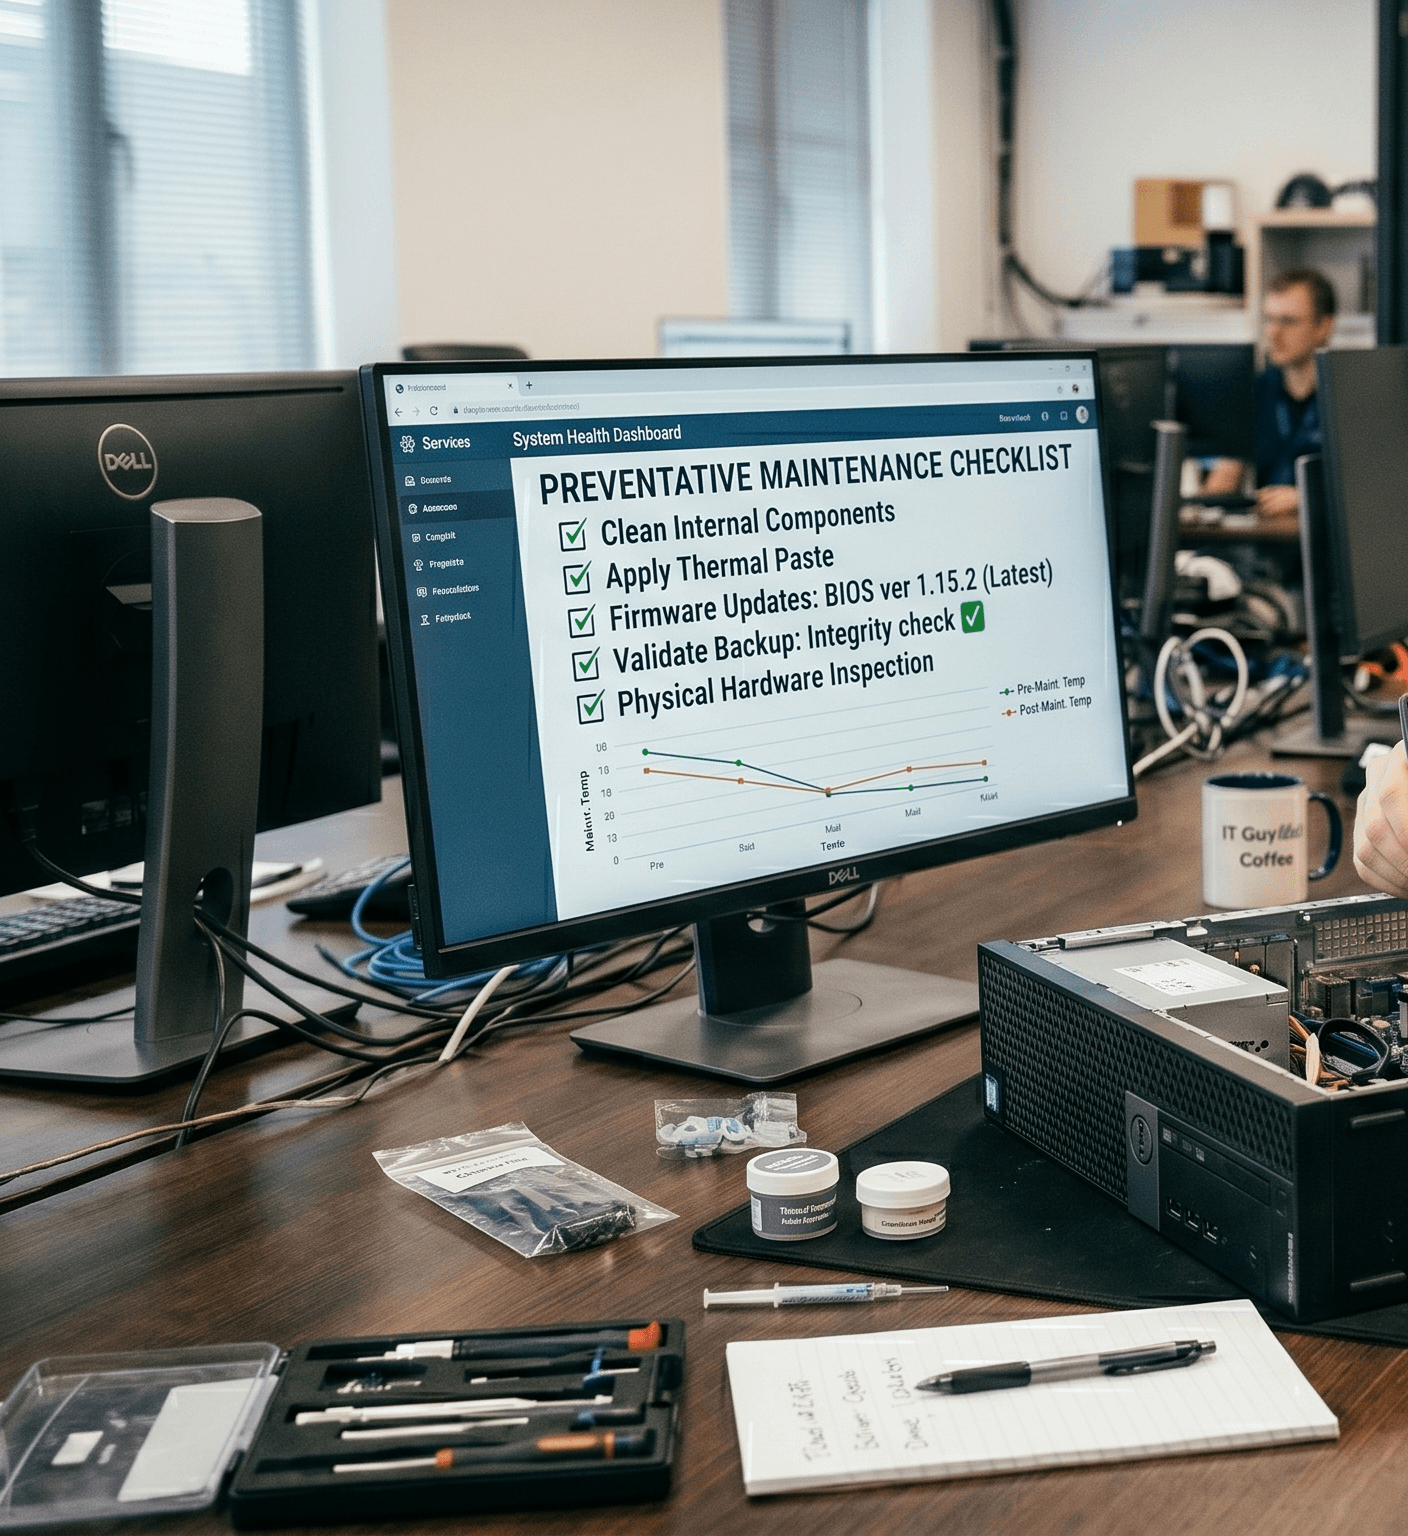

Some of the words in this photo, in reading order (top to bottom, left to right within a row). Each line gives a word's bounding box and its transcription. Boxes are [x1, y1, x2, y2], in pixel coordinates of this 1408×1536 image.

[422, 435, 471, 450] Services
[513, 431, 564, 451] System
[567, 427, 610, 445] Health
[613, 424, 682, 443] Dashboard
[104, 452, 152, 471] DELL
[539, 461, 753, 505] PREVENTATIVE
[759, 450, 944, 490] MAINTENANCE
[950, 443, 1072, 477] CHECKLIST
[601, 517, 667, 546] Clean
[673, 507, 759, 540] Internal
[766, 501, 896, 535] Components
[606, 557, 671, 595] Apply
[676, 547, 769, 582] Thermal
[774, 545, 835, 572] Paste
[609, 600, 717, 632] Firmware
[723, 588, 819, 624] Updates:
[824, 578, 875, 607] BIOS
[879, 580, 911, 601] ver
[916, 567, 978, 596] 1.15.2
[983, 557, 1053, 595] (Latest)
[612, 641, 708, 674] Validate
[714, 629, 801, 660] Backup:
[807, 616, 892, 651] Integrity
[898, 606, 956, 637] check
[617, 677, 715, 720] Physical
[720, 669, 824, 702] Hardware
[829, 651, 934, 689] Inspection
[1017, 679, 1060, 695] Pre-Maint.
[1063, 676, 1086, 689] Temp
[1019, 699, 1067, 716] Post-Maint.
[1069, 696, 1092, 709] Temp
[1222, 825, 1237, 840] IT
[1241, 826, 1277, 844] Guy
[613, 856, 619, 865] 0
[650, 861, 664, 870] Pre
[1239, 851, 1294, 867] Coffee
[828, 866, 860, 885] DELL
